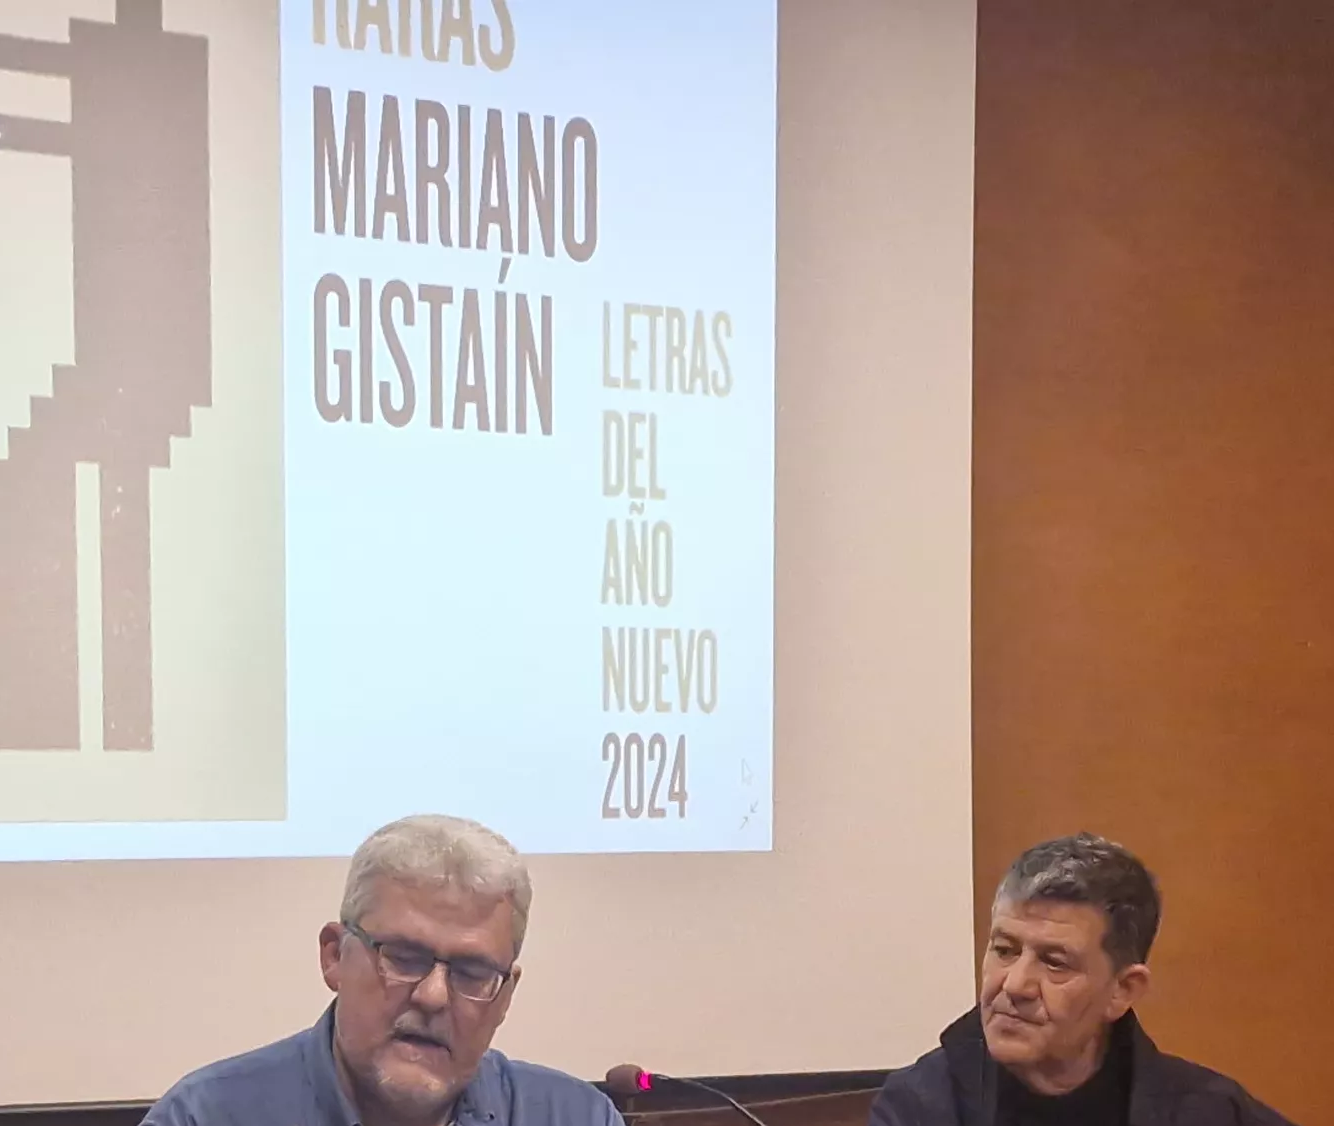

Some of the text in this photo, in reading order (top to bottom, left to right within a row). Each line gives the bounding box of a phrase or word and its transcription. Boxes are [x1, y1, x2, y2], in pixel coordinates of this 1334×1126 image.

[313, 85, 599, 262] MARIANO
[313, 257, 553, 436] GISTAÍN
[602, 301, 733, 398] LETRAS
[602, 410, 667, 500] DEL
[601, 502, 674, 608] AÑO
[602, 626, 719, 715] NUEVO
[601, 732, 688, 820] 2024
